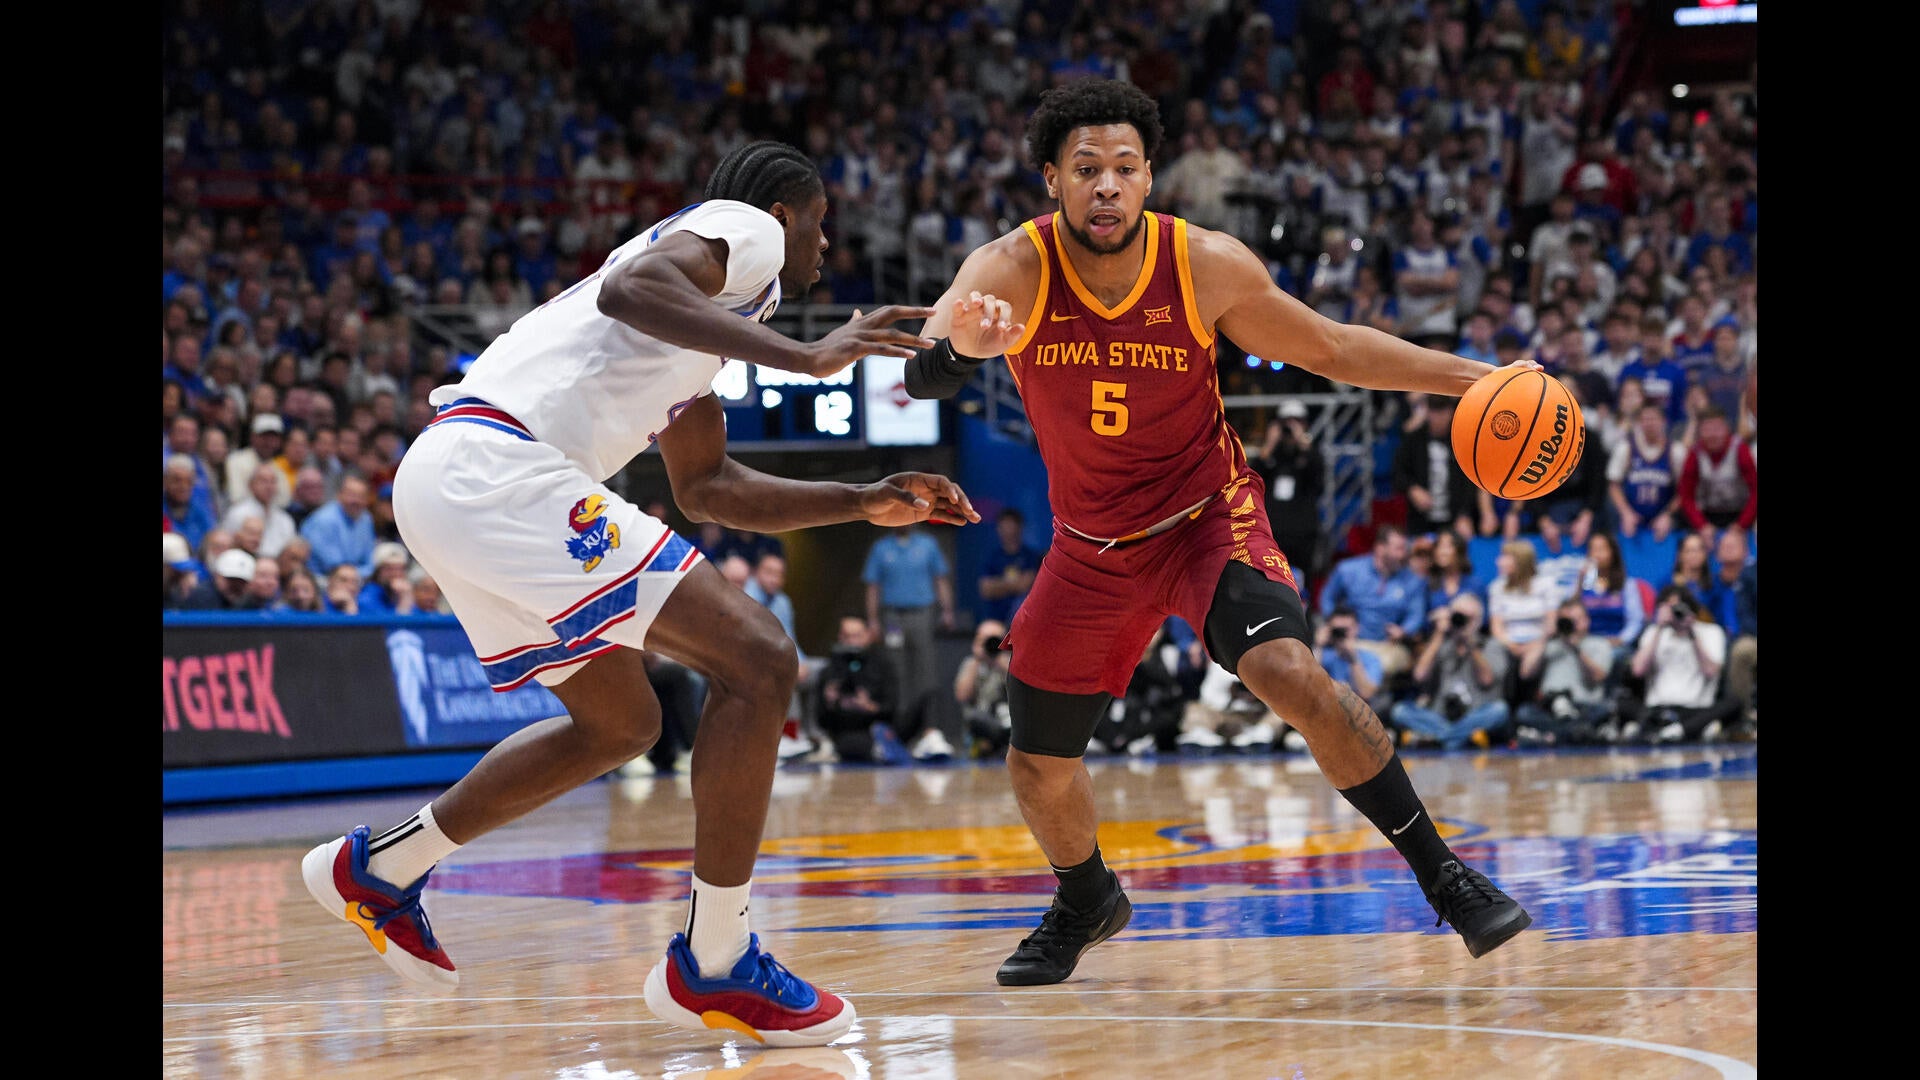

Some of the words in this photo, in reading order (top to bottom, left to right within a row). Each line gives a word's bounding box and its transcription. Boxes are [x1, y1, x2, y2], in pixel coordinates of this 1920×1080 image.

[1035, 342, 1099, 366] IOWA
[1109, 342, 1188, 372] STATE
[1090, 380, 1129, 437] 5
[1517, 404, 1568, 484] Wilson
[582, 530, 601, 549] KU
